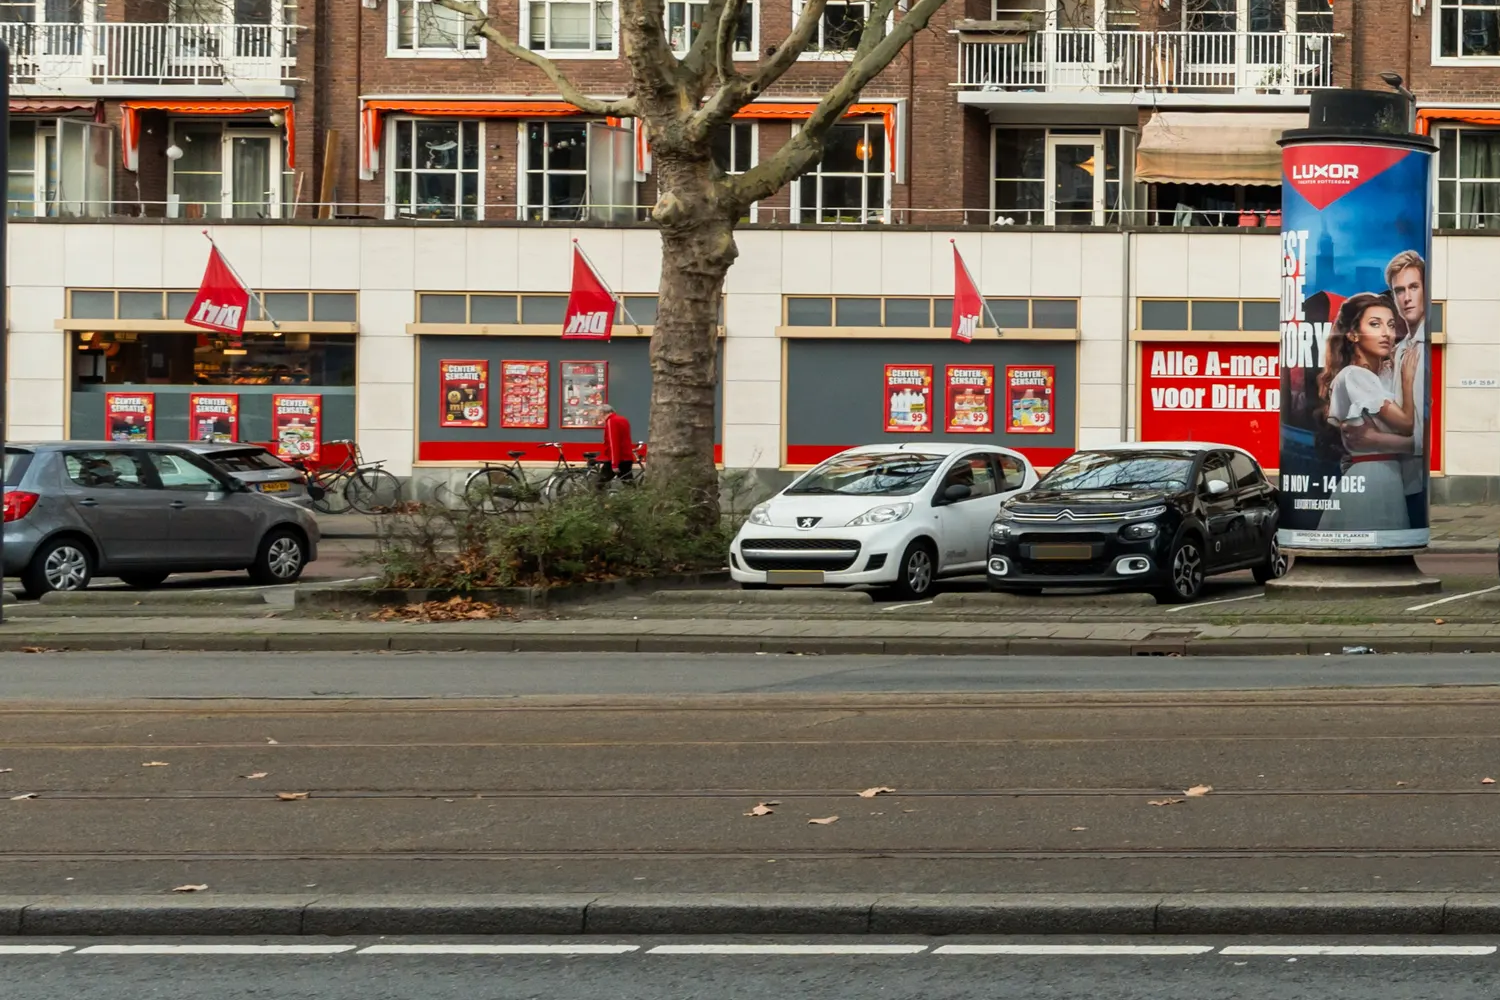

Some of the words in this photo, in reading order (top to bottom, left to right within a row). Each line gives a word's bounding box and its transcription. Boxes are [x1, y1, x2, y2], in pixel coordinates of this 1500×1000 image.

[1292, 164, 1359, 179] LUXOR
[1281, 230, 1309, 276] EST
[1281, 276, 1306, 321] IDE
[1280, 321, 1332, 368] TORY
[1150, 351, 1199, 376] Alle
[1204, 351, 1280, 377] A-mer
[445, 372, 480, 381] SENSATIE
[891, 369, 920, 378] CENTEN
[953, 369, 981, 378] CENTEN
[1014, 370, 1041, 378] CENTEN
[888, 377, 923, 385] SENSATIE
[950, 377, 985, 386] SENSATIE
[1010, 377, 1045, 386] SENSATIE
[1150, 387, 1206, 408] voor
[1211, 384, 1261, 409] Dirk
[1265, 388, 1280, 411] p
[111, 404, 146, 413] SENSATIE
[195, 405, 229, 414] SENSATIE
[277, 406, 311, 415] SENSATIE
[468, 407, 479, 416] 99
[911, 413, 923, 422] 99
[972, 413, 984, 422] 99
[1034, 413, 1046, 422] 99
[299, 442, 311, 451] 89
[1290, 475, 1310, 492] NOV
[1322, 476, 1338, 493] 14
[1341, 476, 1366, 493] DEC
